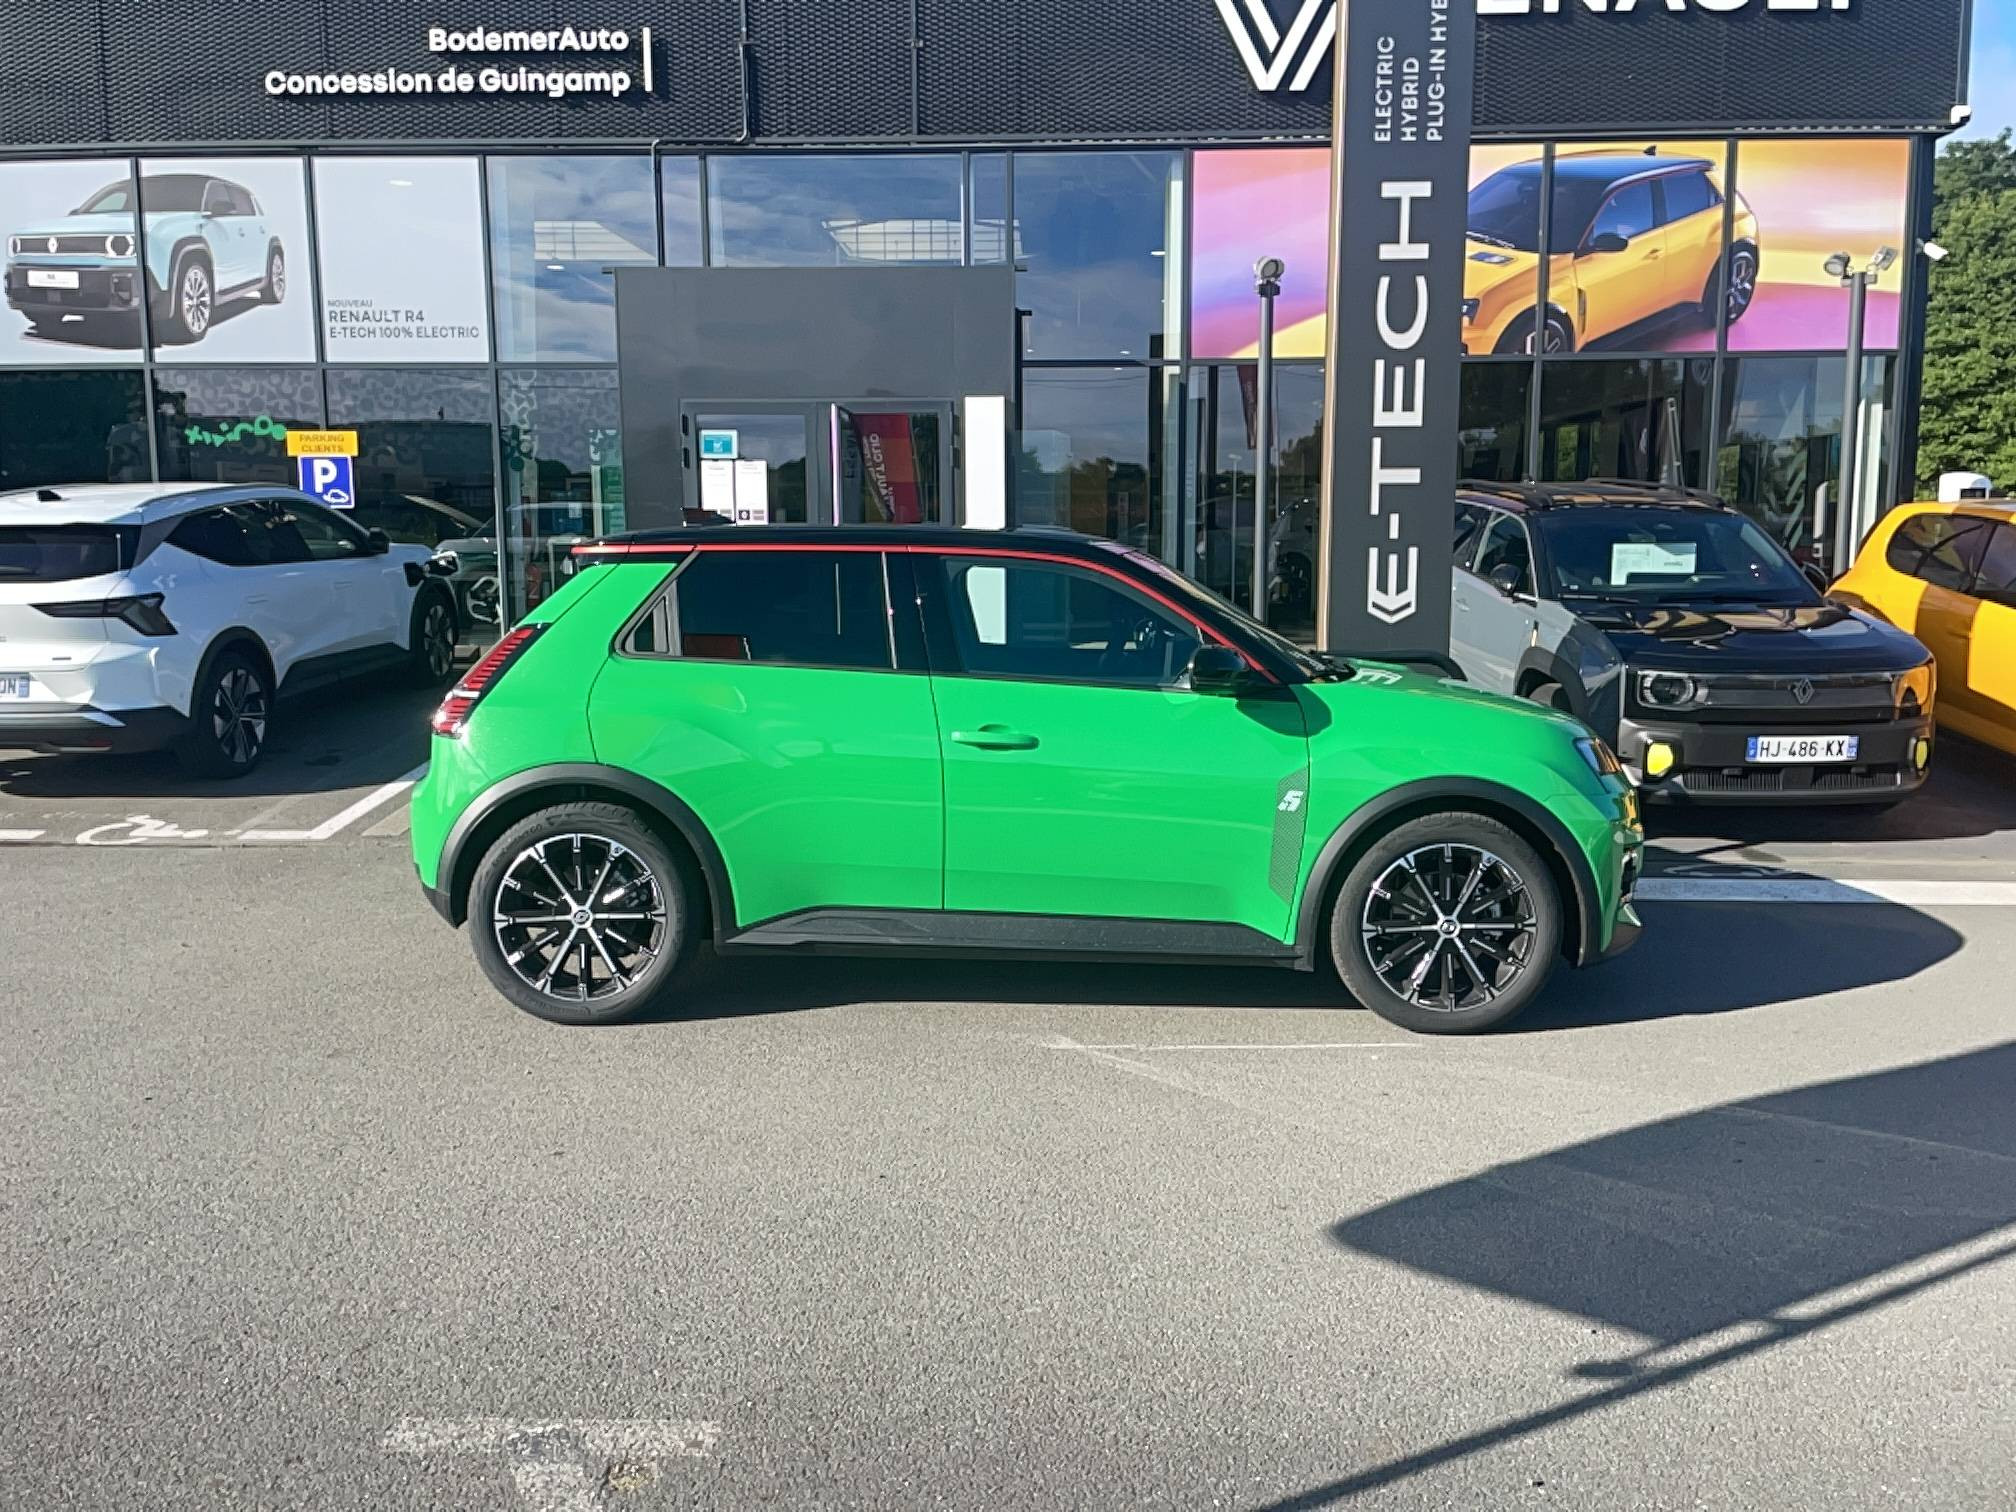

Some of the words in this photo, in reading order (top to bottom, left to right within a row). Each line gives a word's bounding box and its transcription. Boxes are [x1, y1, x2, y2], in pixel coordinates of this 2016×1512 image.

[428, 26, 630, 52] BodemerAuto
[264, 68, 433, 95] Concession
[437, 67, 474, 93] de
[478, 67, 632, 97] Guingamp
[1374, 36, 1396, 142] ELECTRIC
[1426, 48, 1447, 141] PLUG-IN
[1400, 57, 1420, 141] HYBRID
[327, 299, 373, 308] NOUVEAU
[328, 309, 401, 323] RENAULT
[405, 309, 425, 323] R4
[329, 326, 377, 339] E-TECH
[379, 326, 413, 339] 100%
[416, 325, 480, 339] ELECTRIC
[1367, 181, 1432, 624] E-TECH
[298, 433, 346, 443] PARKING
[300, 444, 345, 453] CLIENTS
[312, 458, 338, 494] P
[1759, 739, 1846, 758] HJ-486-KX
